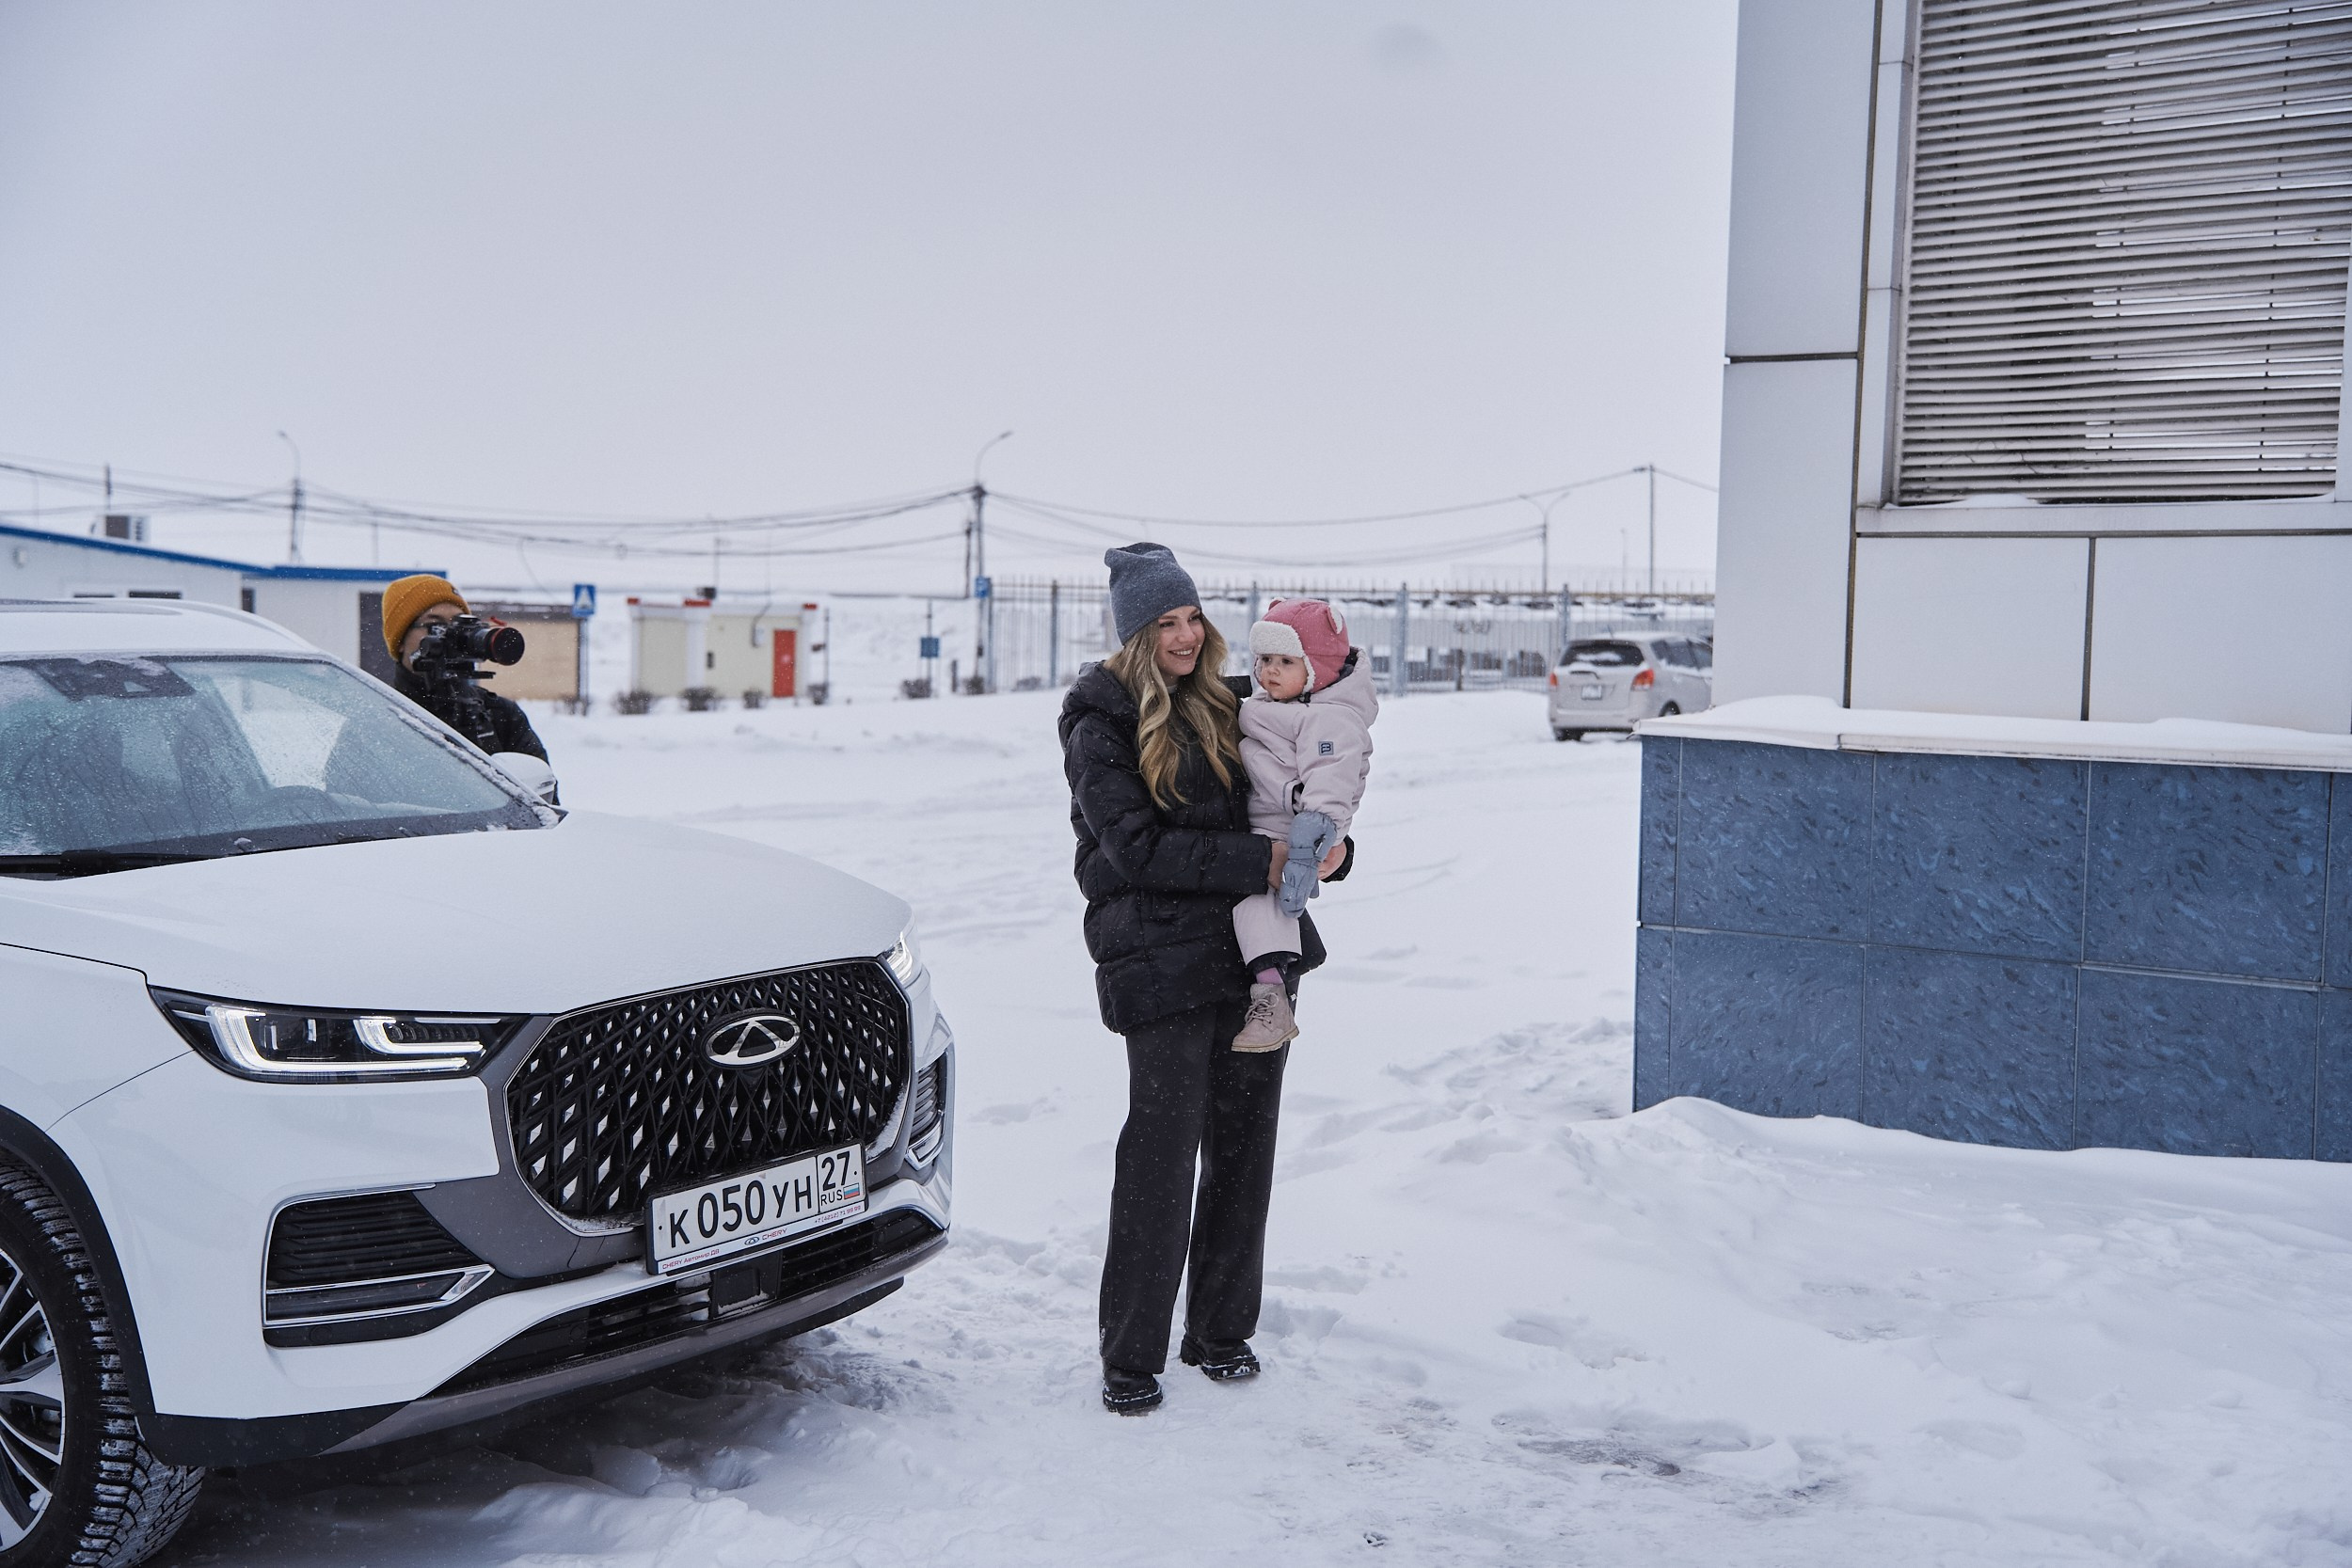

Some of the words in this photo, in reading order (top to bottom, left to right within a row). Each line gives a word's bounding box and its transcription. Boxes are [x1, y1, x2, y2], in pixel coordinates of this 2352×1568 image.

[820, 1150, 850, 1192] 27
[820, 1189, 843, 1207] RUS
[762, 1228, 787, 1241] CHERY
[662, 1259, 683, 1270] CHERY
